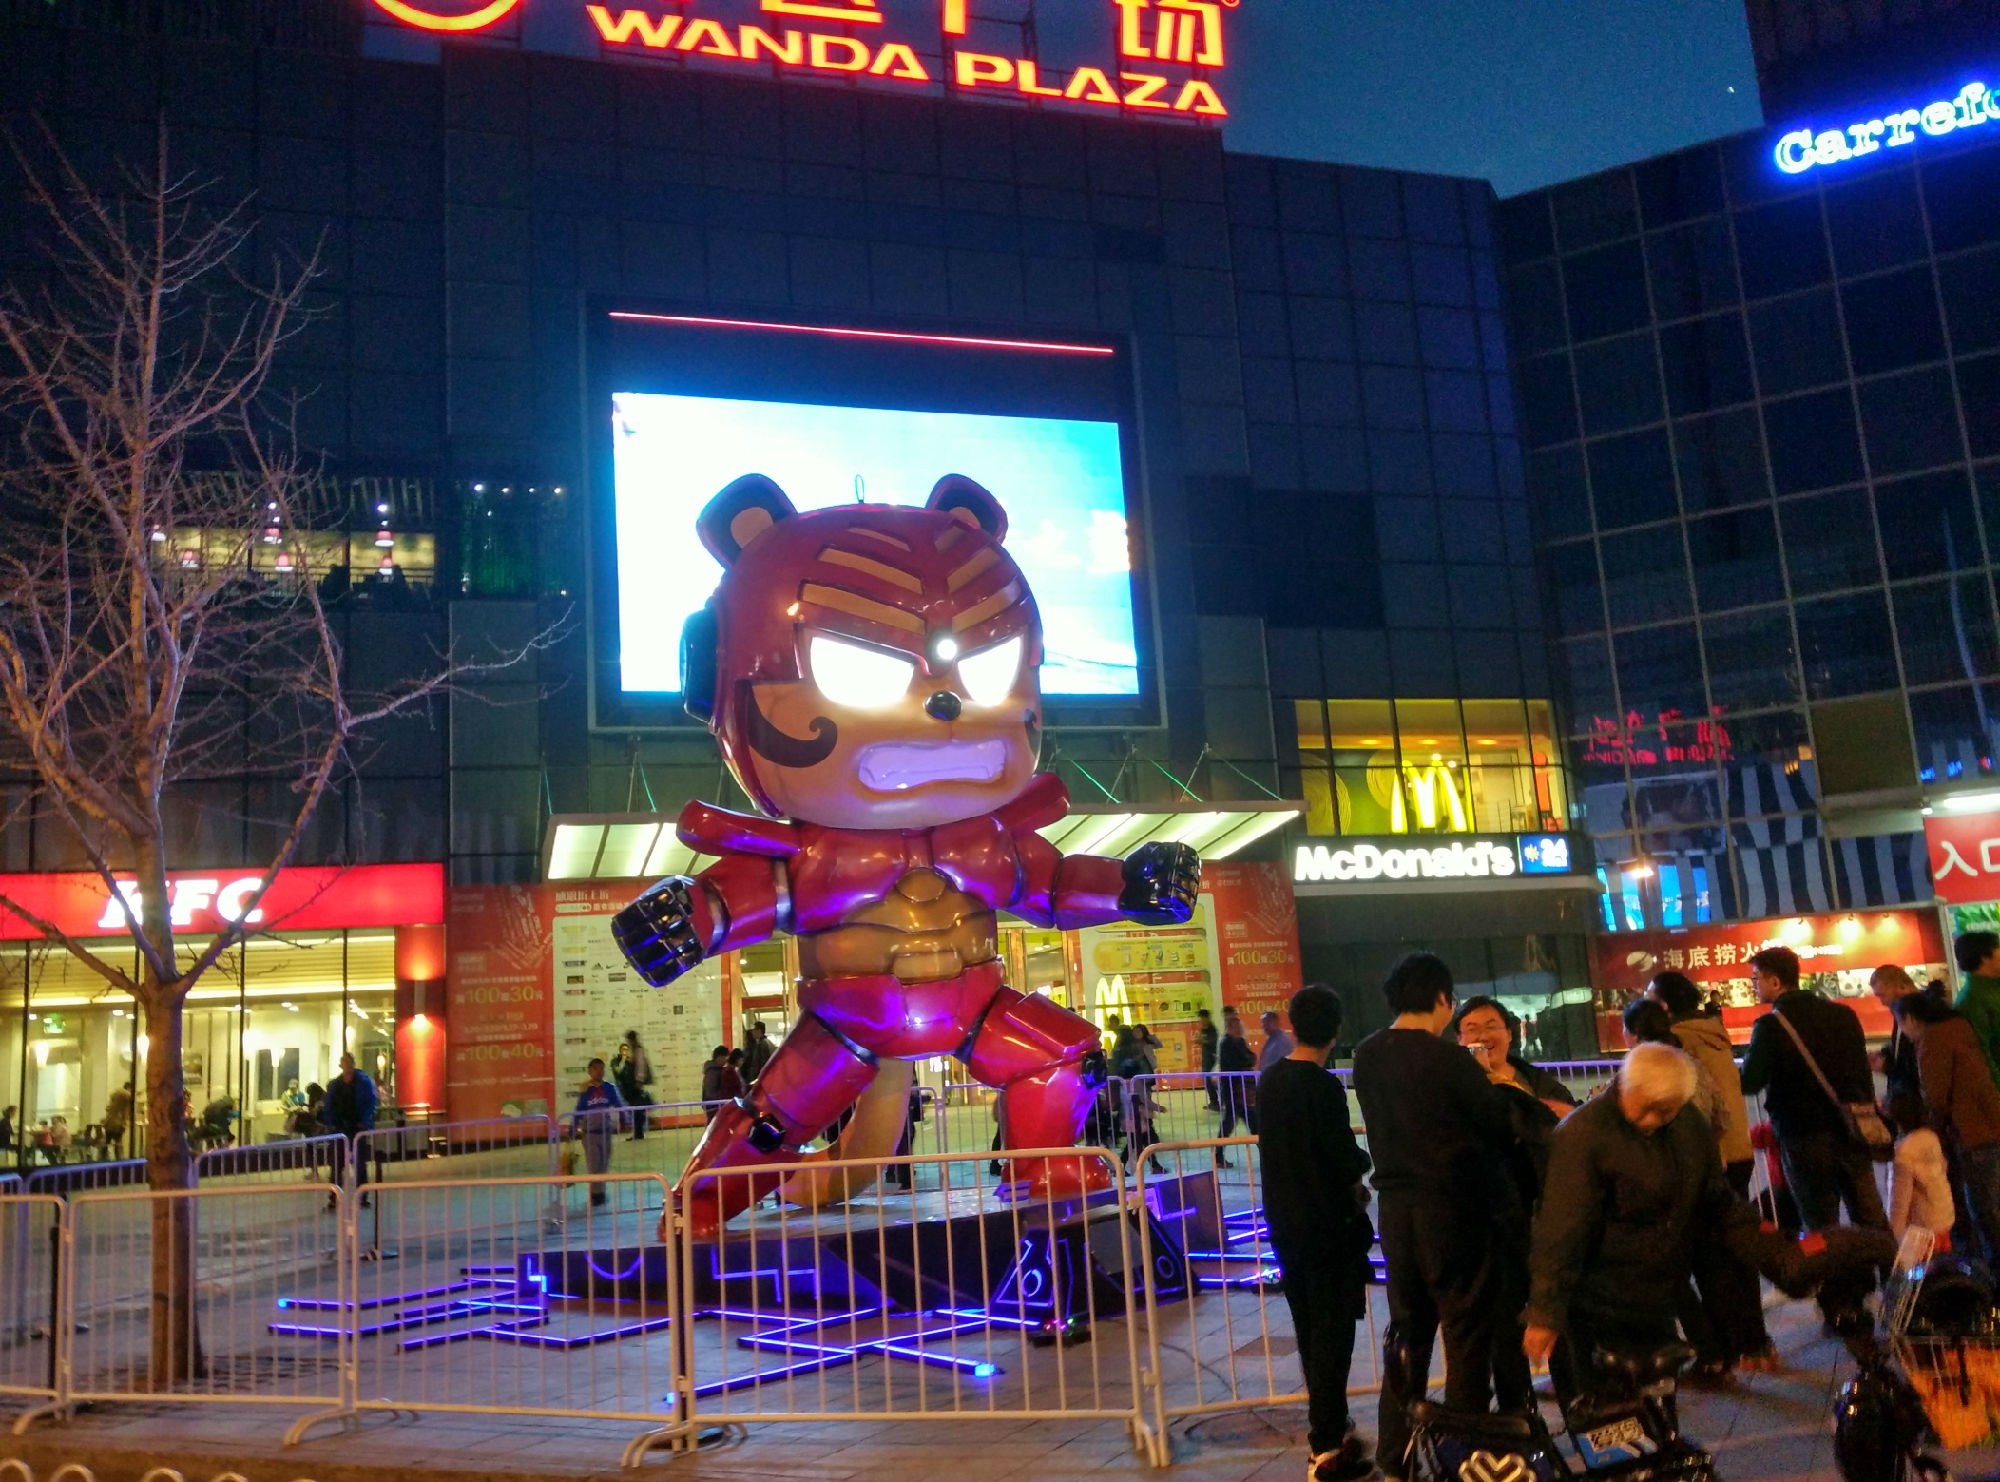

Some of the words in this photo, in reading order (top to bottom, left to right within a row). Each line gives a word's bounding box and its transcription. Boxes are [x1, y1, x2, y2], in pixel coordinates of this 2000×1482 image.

[585, 5, 929, 81] WANDA
[954, 50, 1228, 116] PLAZA
[1294, 840, 1516, 881] McDonald's
